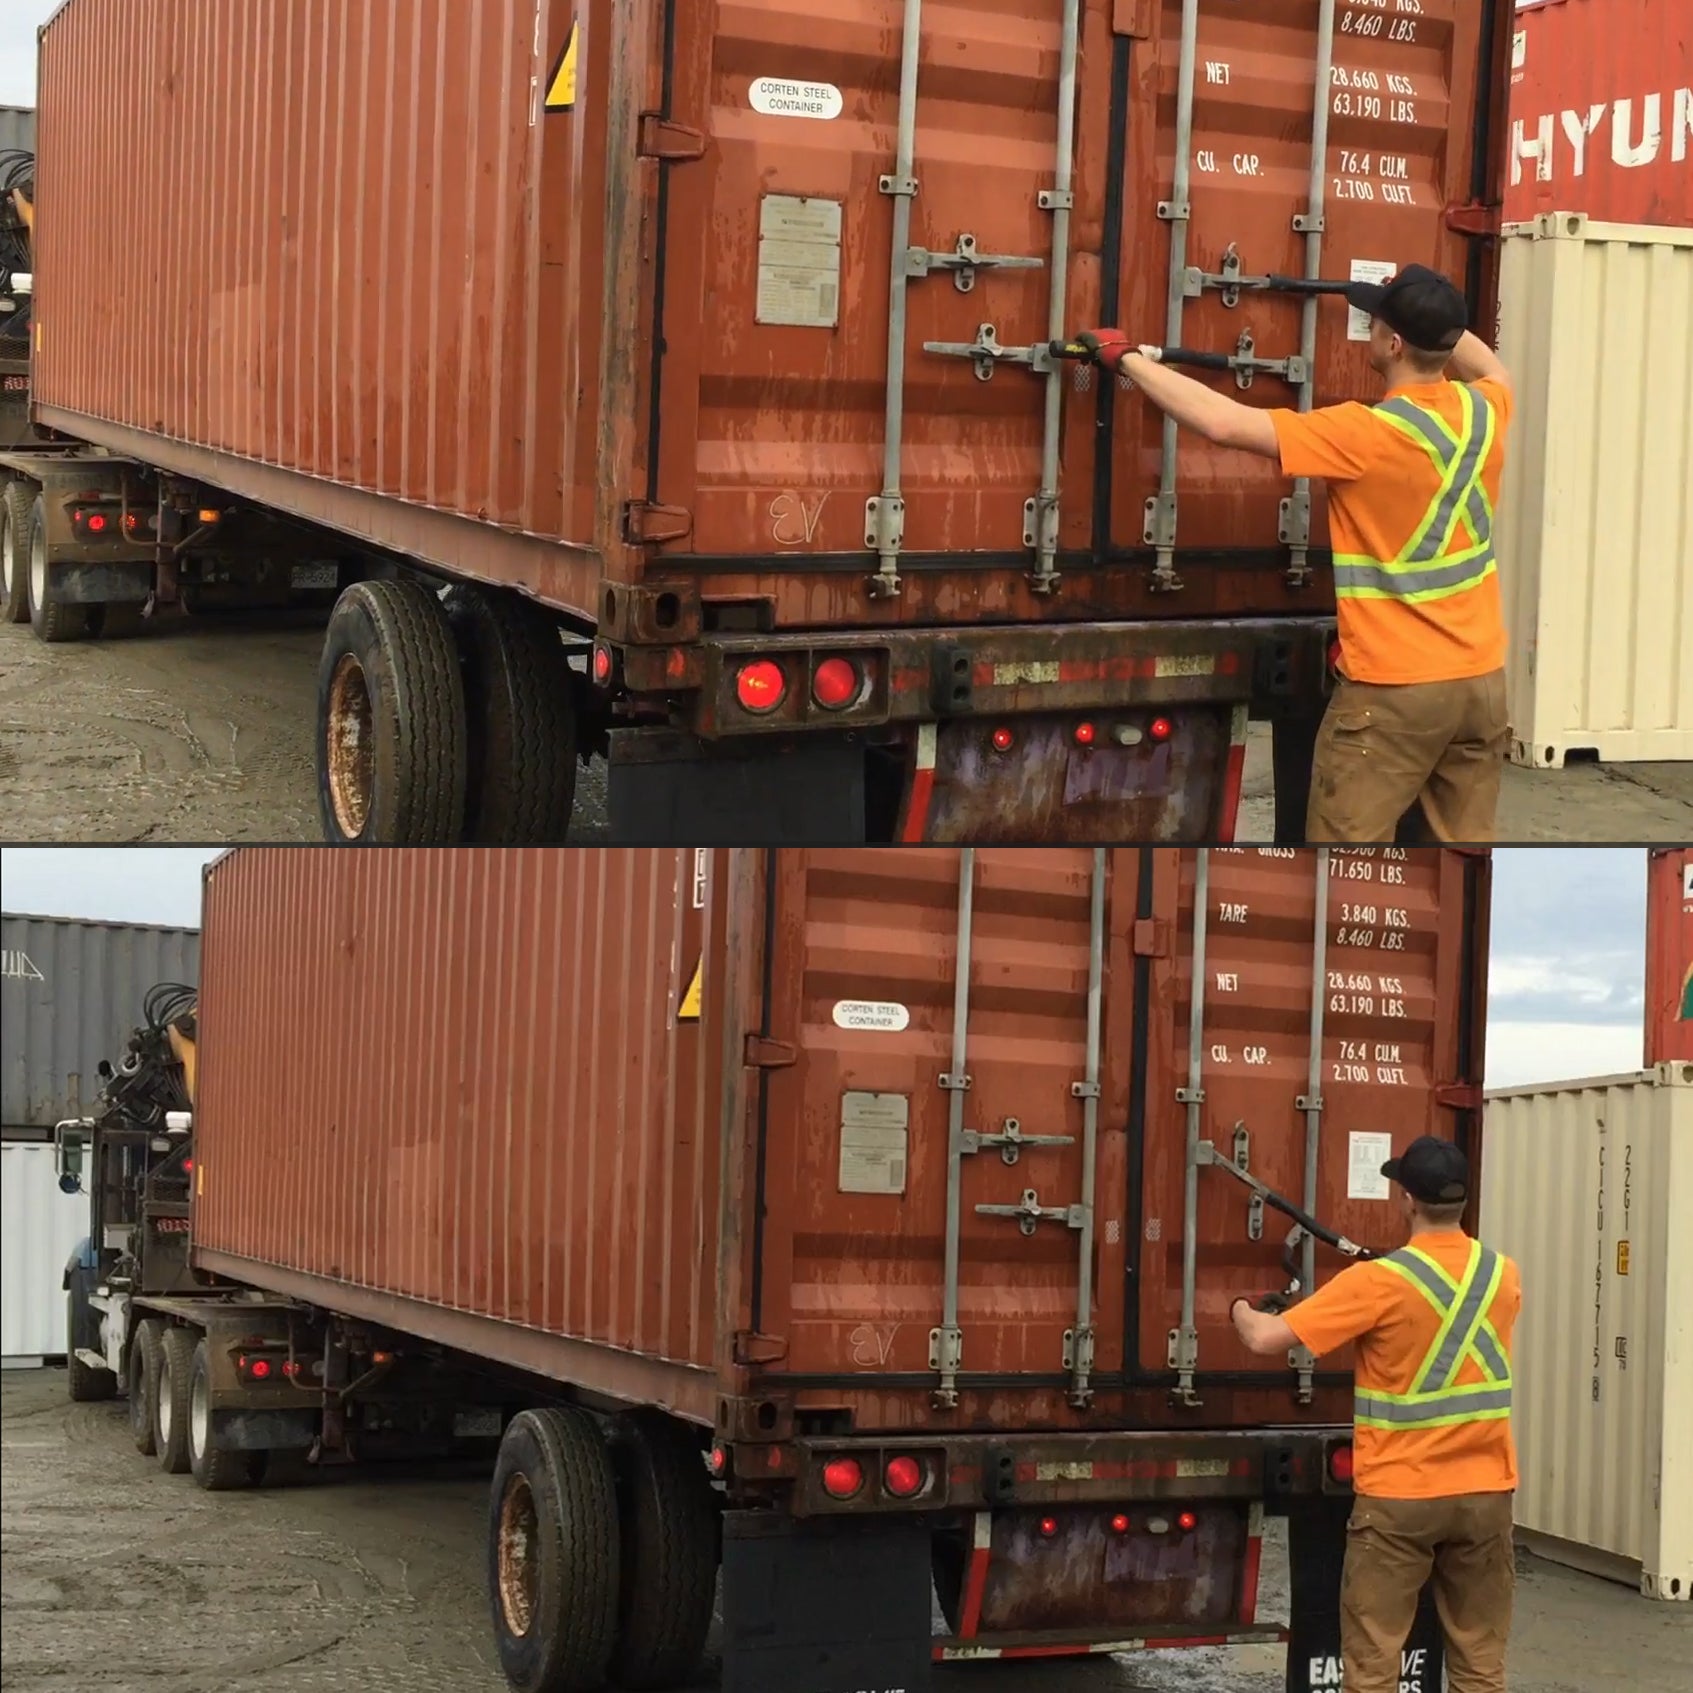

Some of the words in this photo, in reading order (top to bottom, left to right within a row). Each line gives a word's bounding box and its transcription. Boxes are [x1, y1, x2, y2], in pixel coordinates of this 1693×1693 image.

[1388, 18, 1417, 42] LBS.
[1205, 61, 1230, 85] NET
[1385, 73, 1418, 96] KGS.
[760, 82, 799, 96] CORTEN
[803, 86, 832, 100] STEEL
[768, 98, 823, 113] CONTAINER
[1390, 99, 1418, 123] LBS.
[1197, 150, 1220, 173] CU.
[1233, 153, 1265, 177] CAP.
[1340, 150, 1371, 175] 76.4
[1333, 178, 1374, 200] 2.700
[1329, 858, 1372, 881] 71.650
[1380, 864, 1407, 885] LBS.
[1219, 902, 1248, 924] TARE
[1341, 903, 1377, 925] 3.840
[1384, 908, 1411, 928] KGS.
[1379, 931, 1406, 951] LBS.
[1216, 973, 1238, 992] NET
[1328, 972, 1372, 991] 28.660
[1378, 976, 1408, 995] KGS.
[842, 1004, 873, 1015] CORTEN
[877, 1006, 900, 1016] STEEL
[1381, 998, 1408, 1018] LBS.
[849, 1016, 893, 1027] CONTAINER
[1211, 1045, 1232, 1064] CU.
[1243, 1046, 1272, 1065] CAP.
[1340, 1041, 1367, 1061] 76.4
[1333, 1064, 1369, 1083] 2.700
